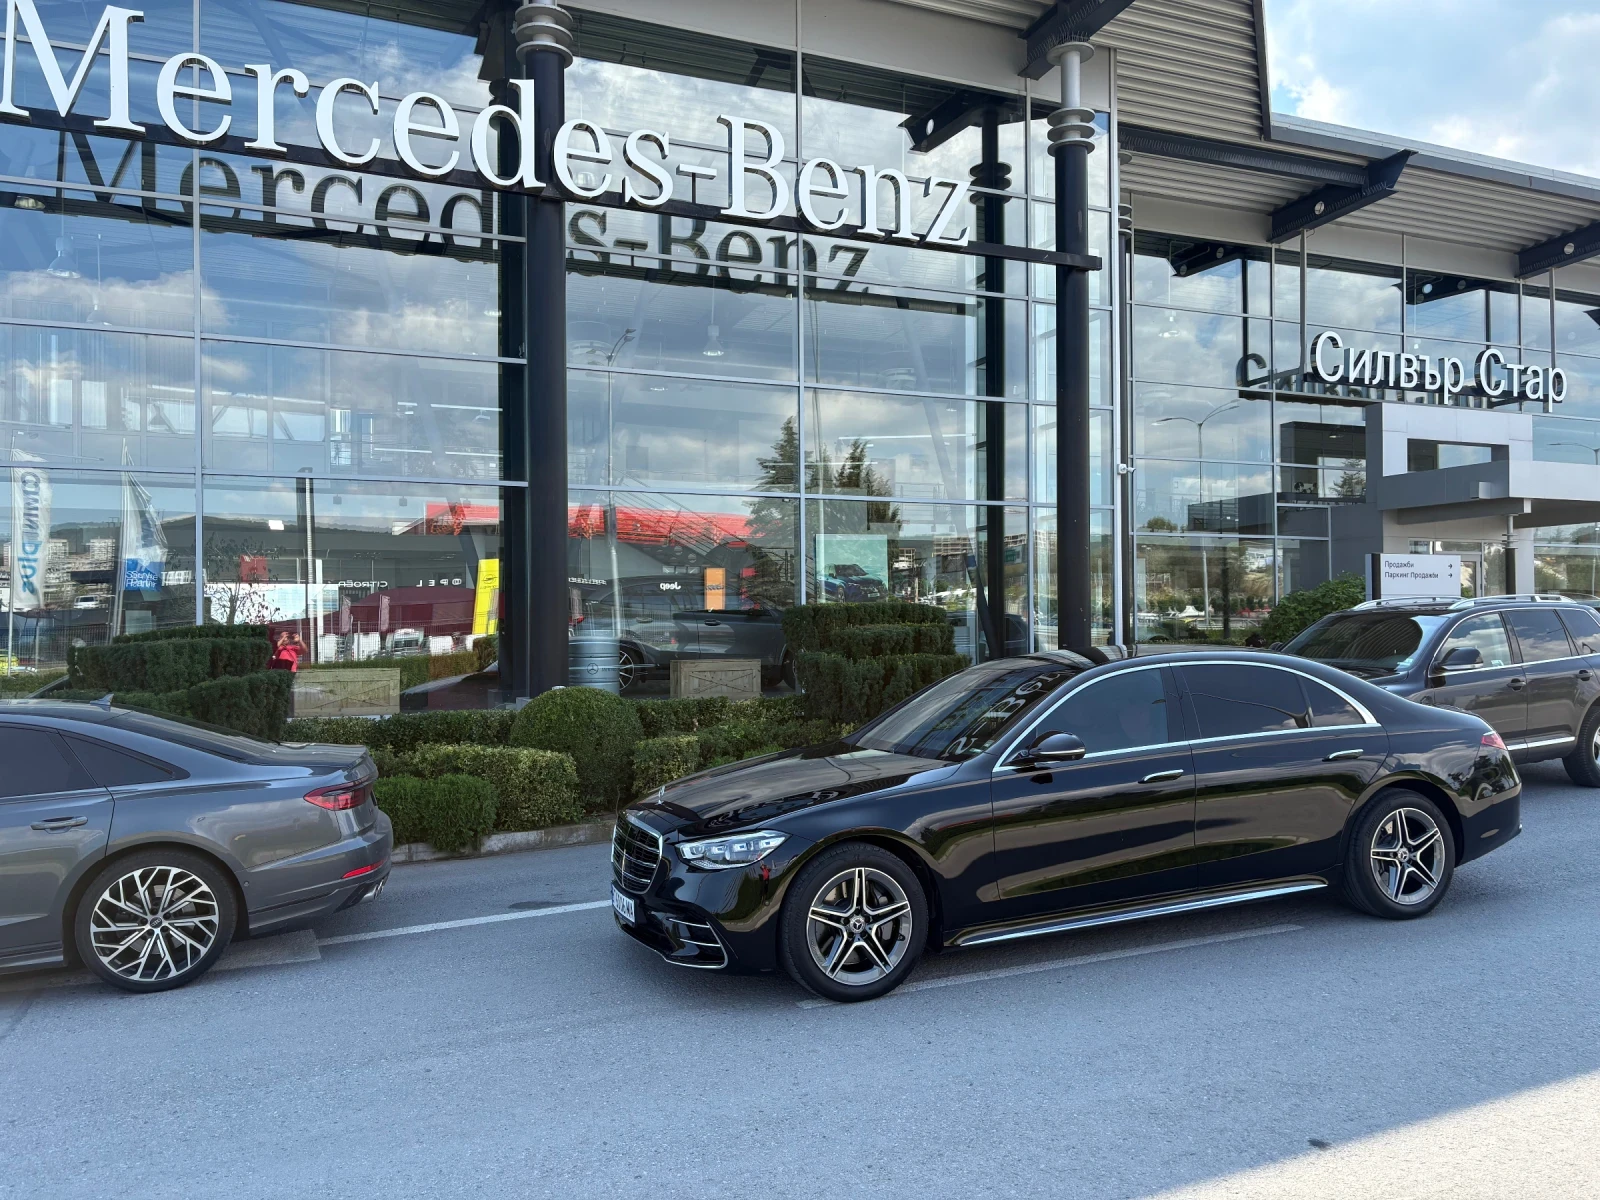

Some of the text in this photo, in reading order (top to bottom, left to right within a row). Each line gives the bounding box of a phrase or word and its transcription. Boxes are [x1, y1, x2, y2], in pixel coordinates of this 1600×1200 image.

[0, 0, 971, 247] Mercedes-Benz
[1312, 331, 1567, 412] Силвър Стар
[1384, 561, 1414, 569] Продажби
[1384, 571, 1409, 580] Паркинг
